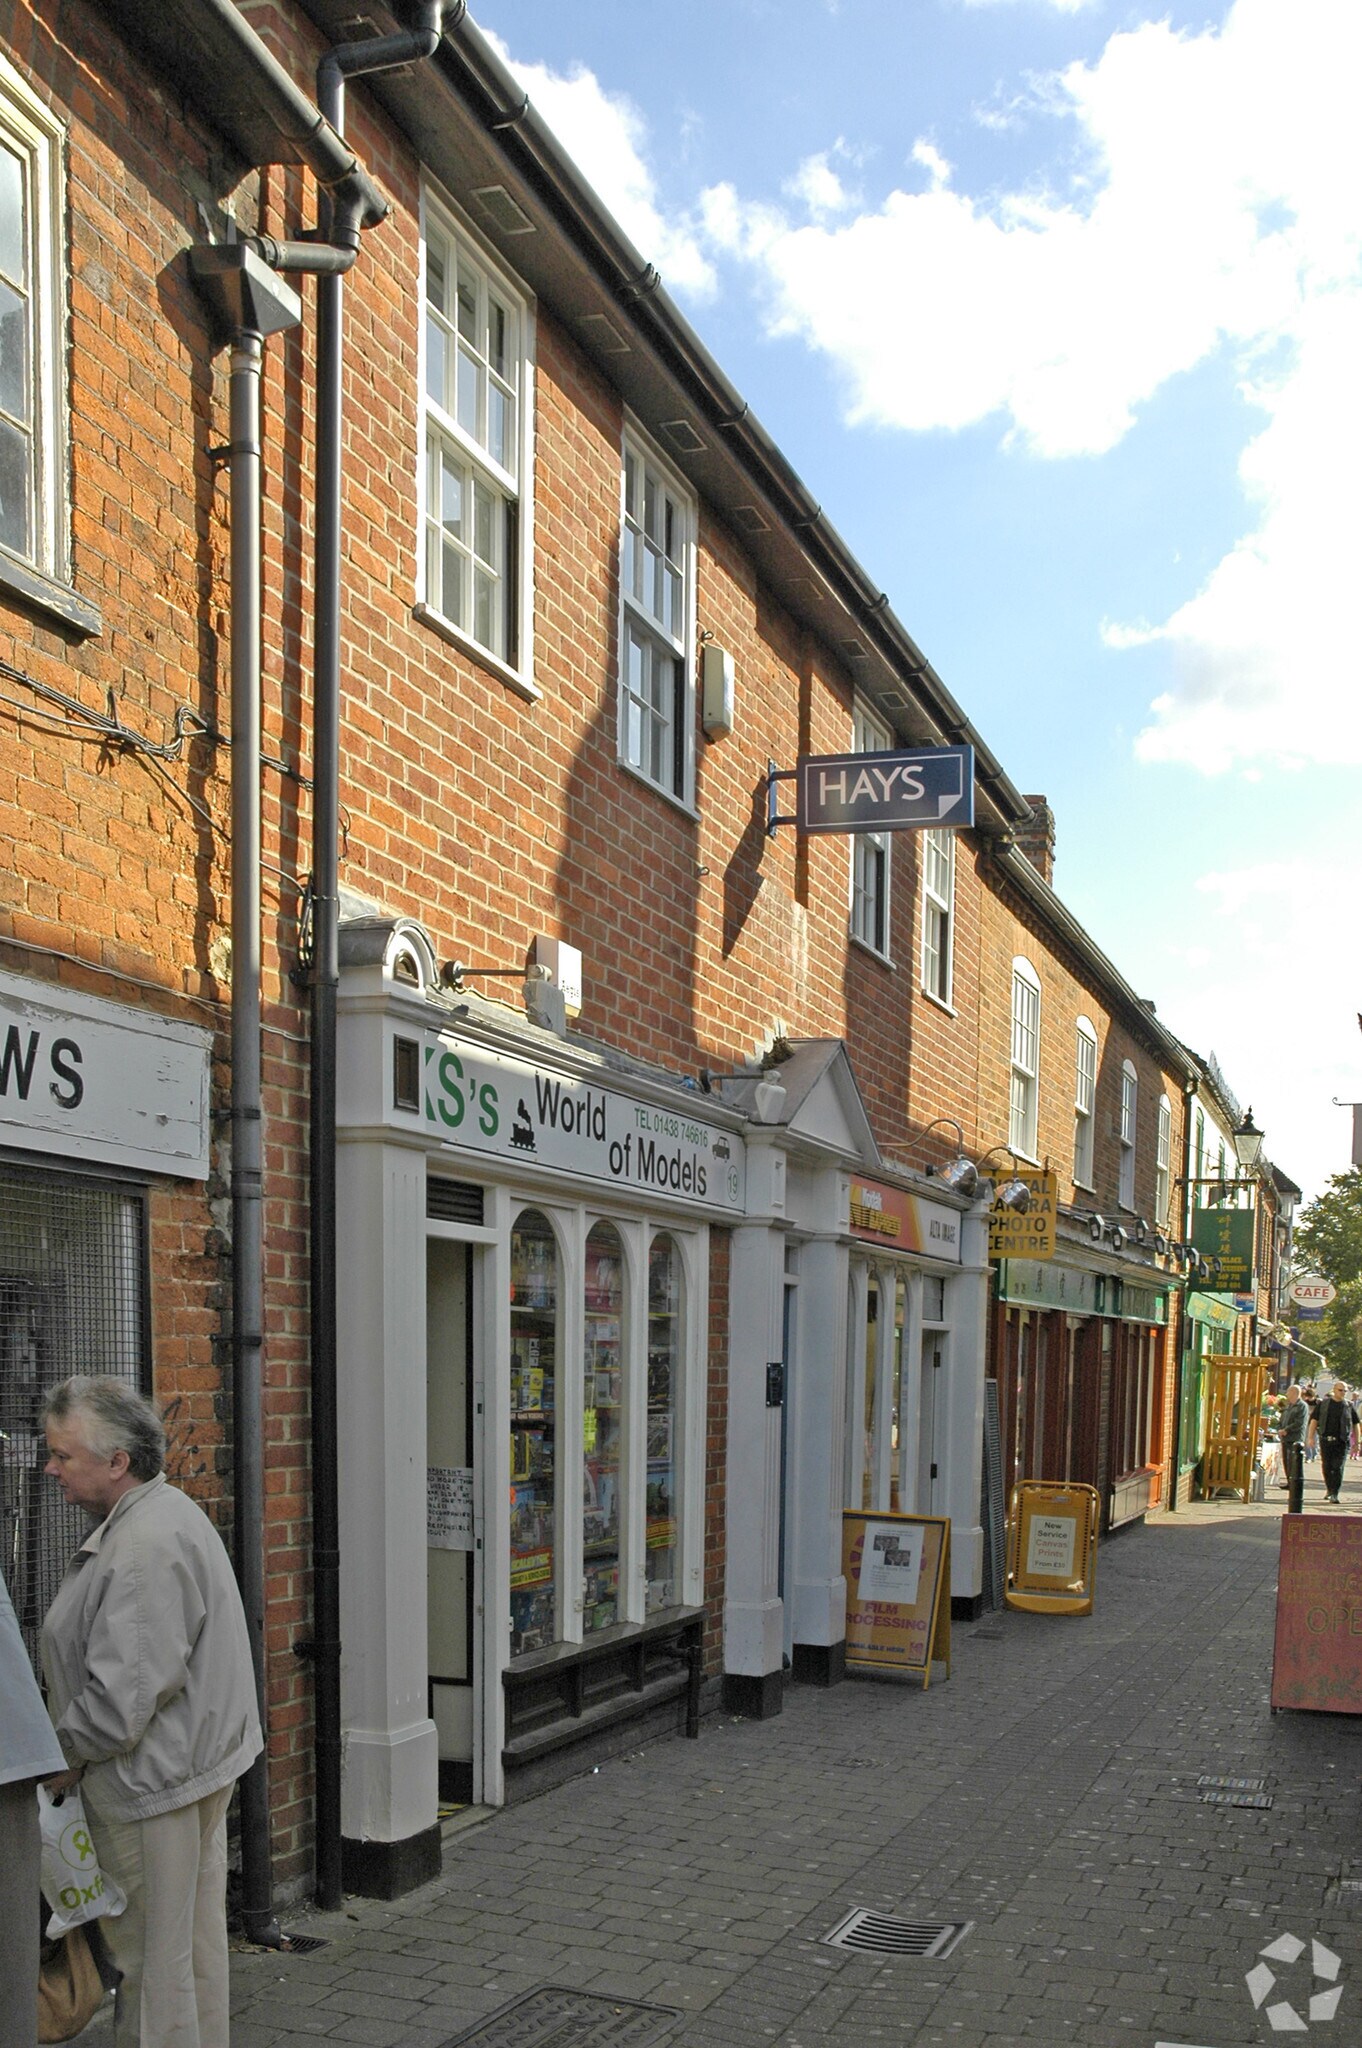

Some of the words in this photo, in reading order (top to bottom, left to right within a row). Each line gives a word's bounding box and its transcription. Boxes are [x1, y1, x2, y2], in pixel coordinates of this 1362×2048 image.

[819, 765, 926, 806] HAYS
[534, 1073, 607, 1142] World
[634, 1107, 652, 1131] TEL
[653, 1113, 680, 1139] 01438
[608, 1132, 632, 1178] of
[637, 1136, 707, 1197] Models
[988, 1217, 1047, 1233] PHOTO
[1294, 1287, 1330, 1298] CAFE
[1044, 1521, 1063, 1530] New
[1287, 1522, 1342, 1544] FLESH
[1037, 1529, 1068, 1540] Service
[1035, 1538, 1068, 1549] Canvas
[1037, 1548, 1065, 1558] Prints
[1034, 1560, 1053, 1568] From
[864, 1601, 899, 1616] FILM
